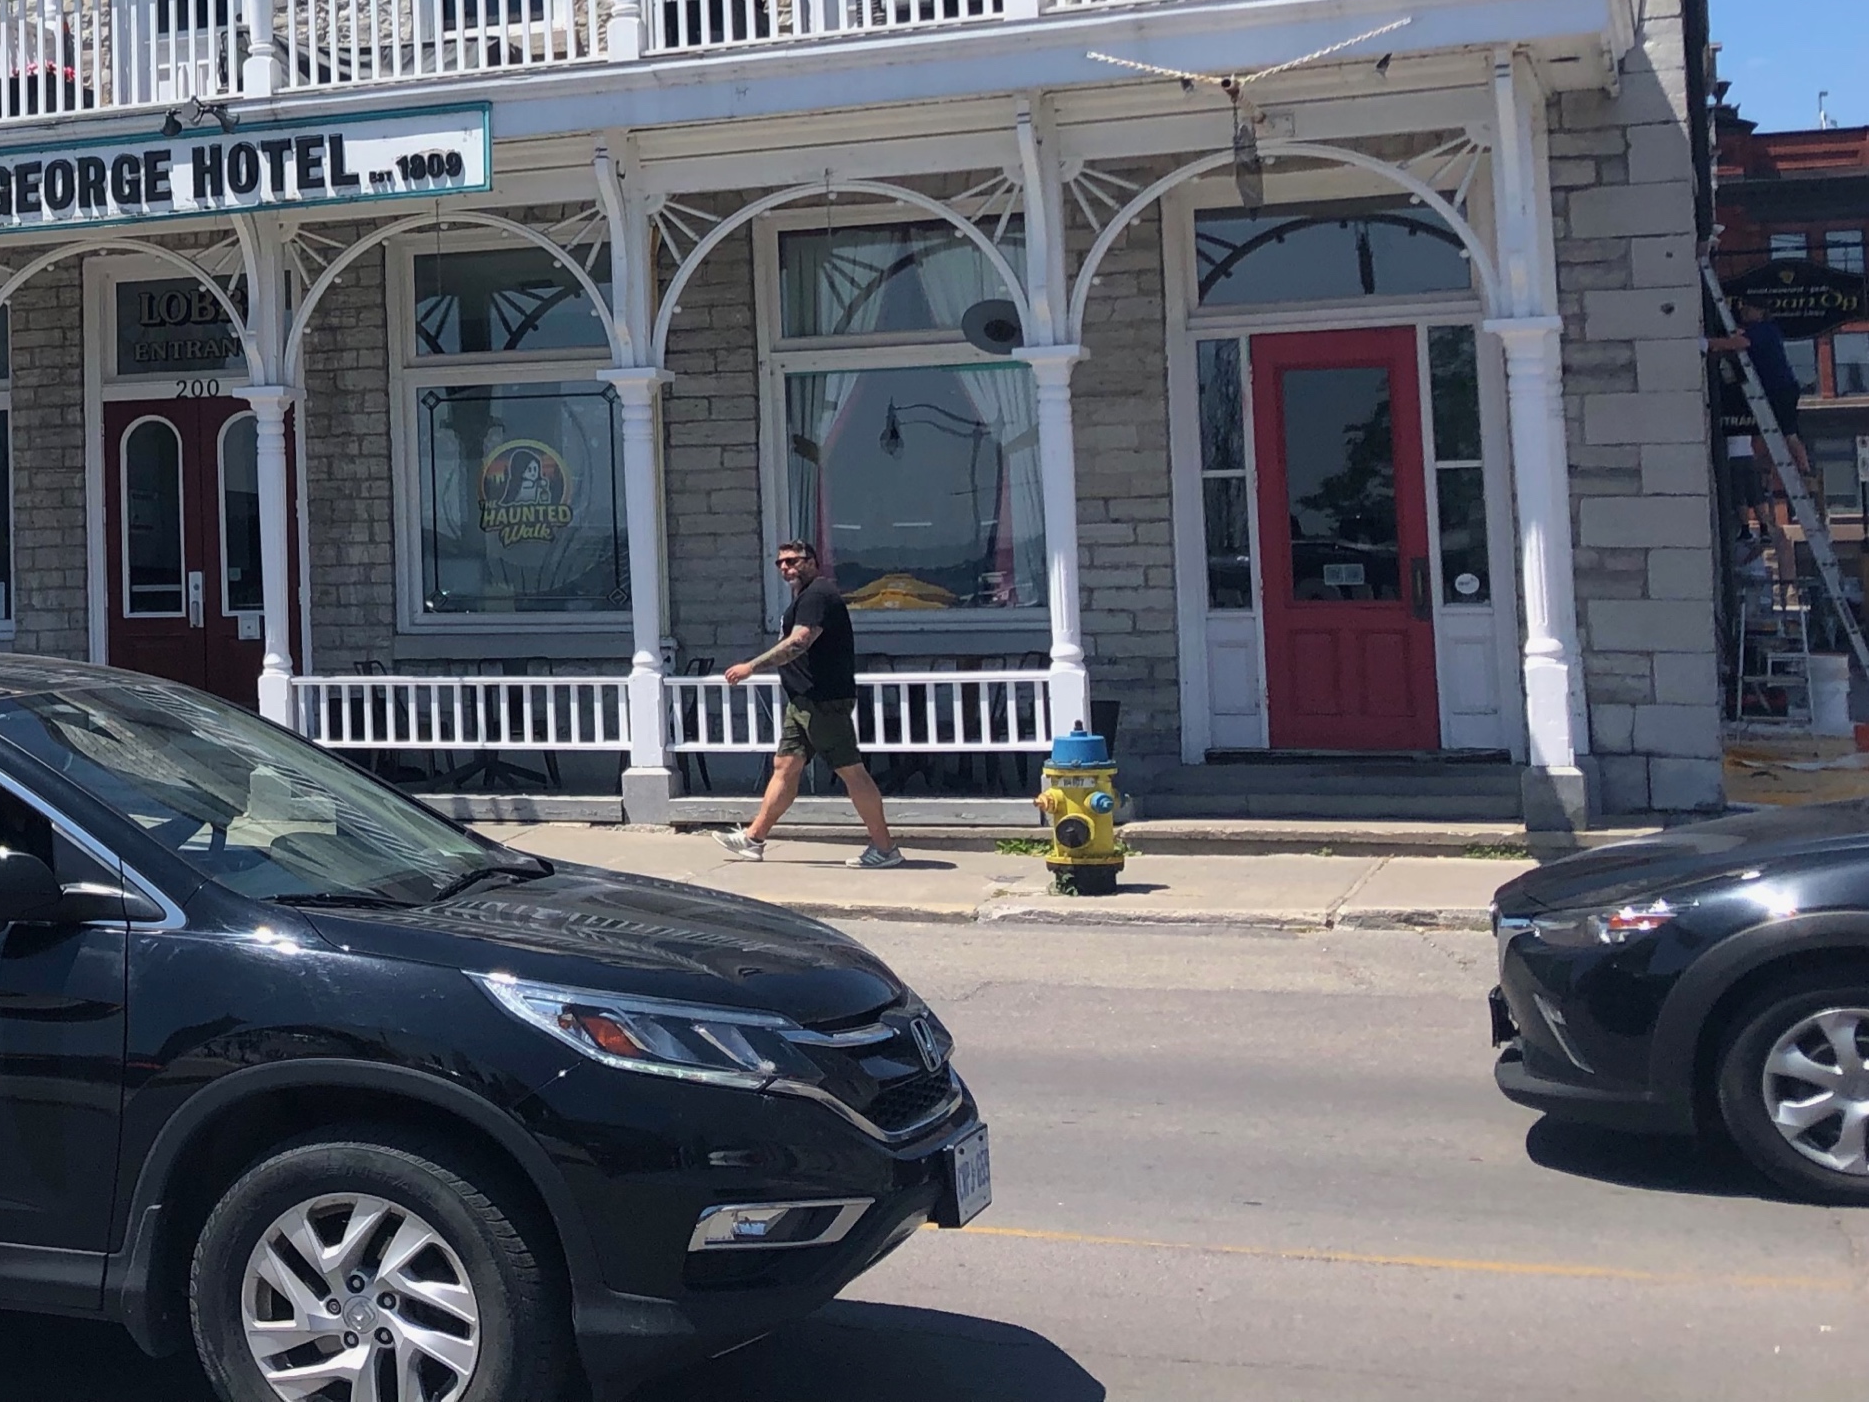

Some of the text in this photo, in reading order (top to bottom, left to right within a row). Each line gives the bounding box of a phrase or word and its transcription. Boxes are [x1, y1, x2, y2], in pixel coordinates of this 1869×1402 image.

[192, 133, 359, 198] HOTEL
[396, 152, 462, 181] 1809
[134, 339, 239, 361] ENTRAN
[176, 378, 220, 398] 200
[482, 505, 571, 527] HAUNTED
[501, 523, 551, 546] Walk
